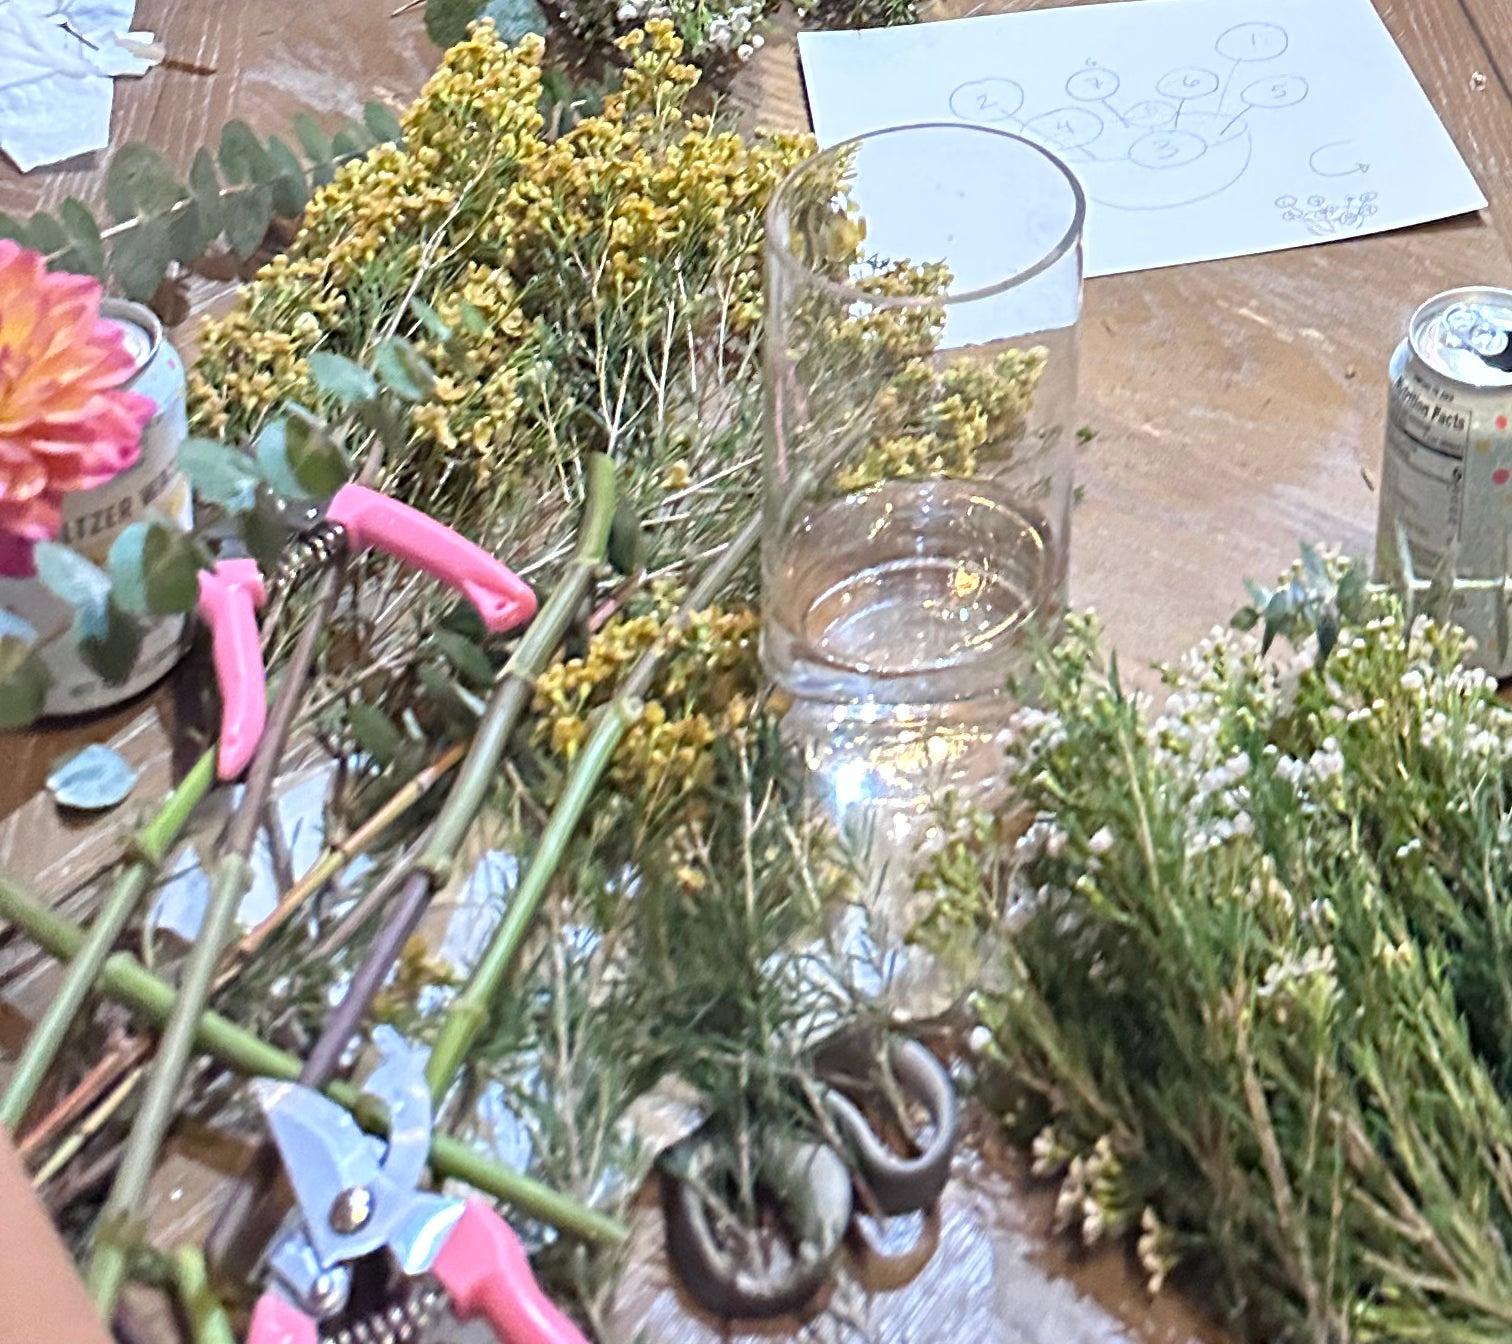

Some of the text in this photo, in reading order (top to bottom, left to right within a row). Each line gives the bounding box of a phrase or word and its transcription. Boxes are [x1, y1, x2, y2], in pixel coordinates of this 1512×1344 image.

[1182, 74, 1201, 89] 6
[976, 92, 999, 111] 2
[1056, 119, 1075, 135] 4
[1152, 138, 1180, 161] 3
[1431, 404, 1466, 431] Facts
[61, 495, 133, 545] LTZER
